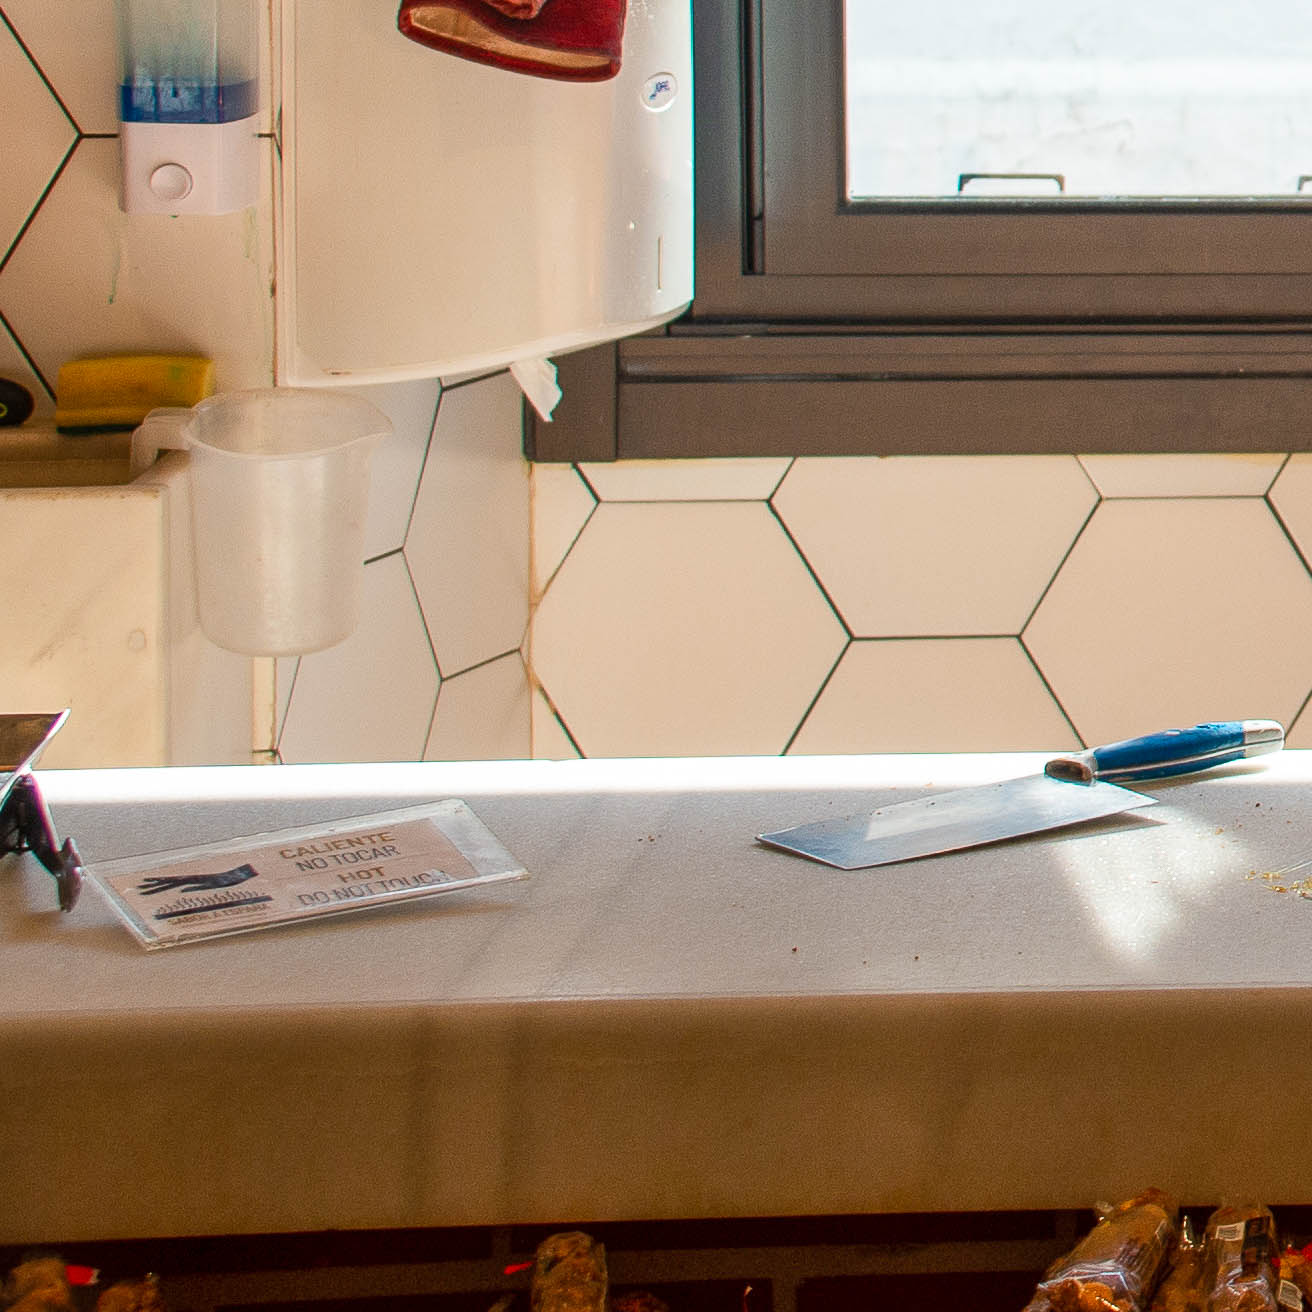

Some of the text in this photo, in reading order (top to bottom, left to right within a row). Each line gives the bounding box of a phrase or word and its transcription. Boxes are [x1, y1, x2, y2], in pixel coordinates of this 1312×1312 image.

[280, 831, 396, 860] CALIENTE
[296, 844, 401, 872] NO TOCAR
[337, 866, 386, 883] HOT
[298, 890, 331, 906] DO
[331, 881, 374, 902] NOT
